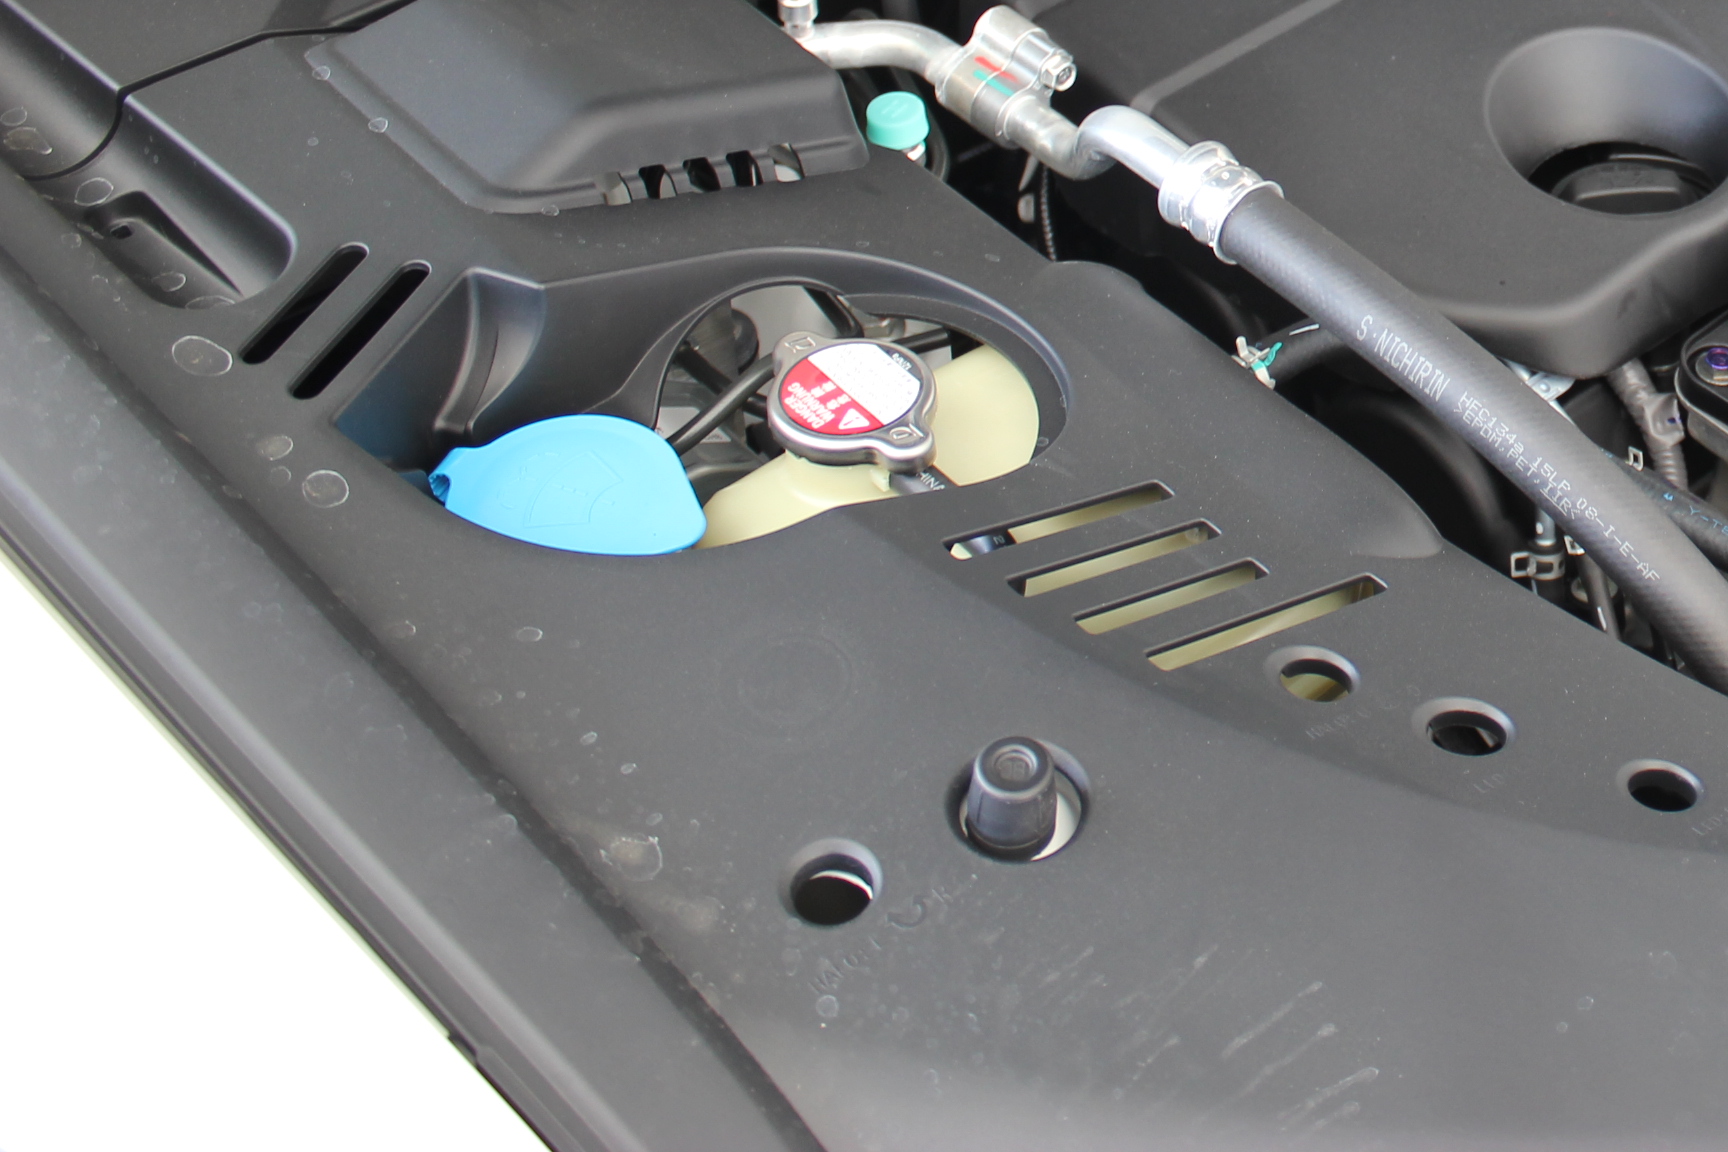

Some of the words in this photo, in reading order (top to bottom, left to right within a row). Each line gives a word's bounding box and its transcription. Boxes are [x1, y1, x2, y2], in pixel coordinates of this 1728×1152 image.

[783, 394, 826, 429] DANGER
[787, 381, 836, 423] WARNUNG
[1459, 390, 1525, 455] HFC134a
